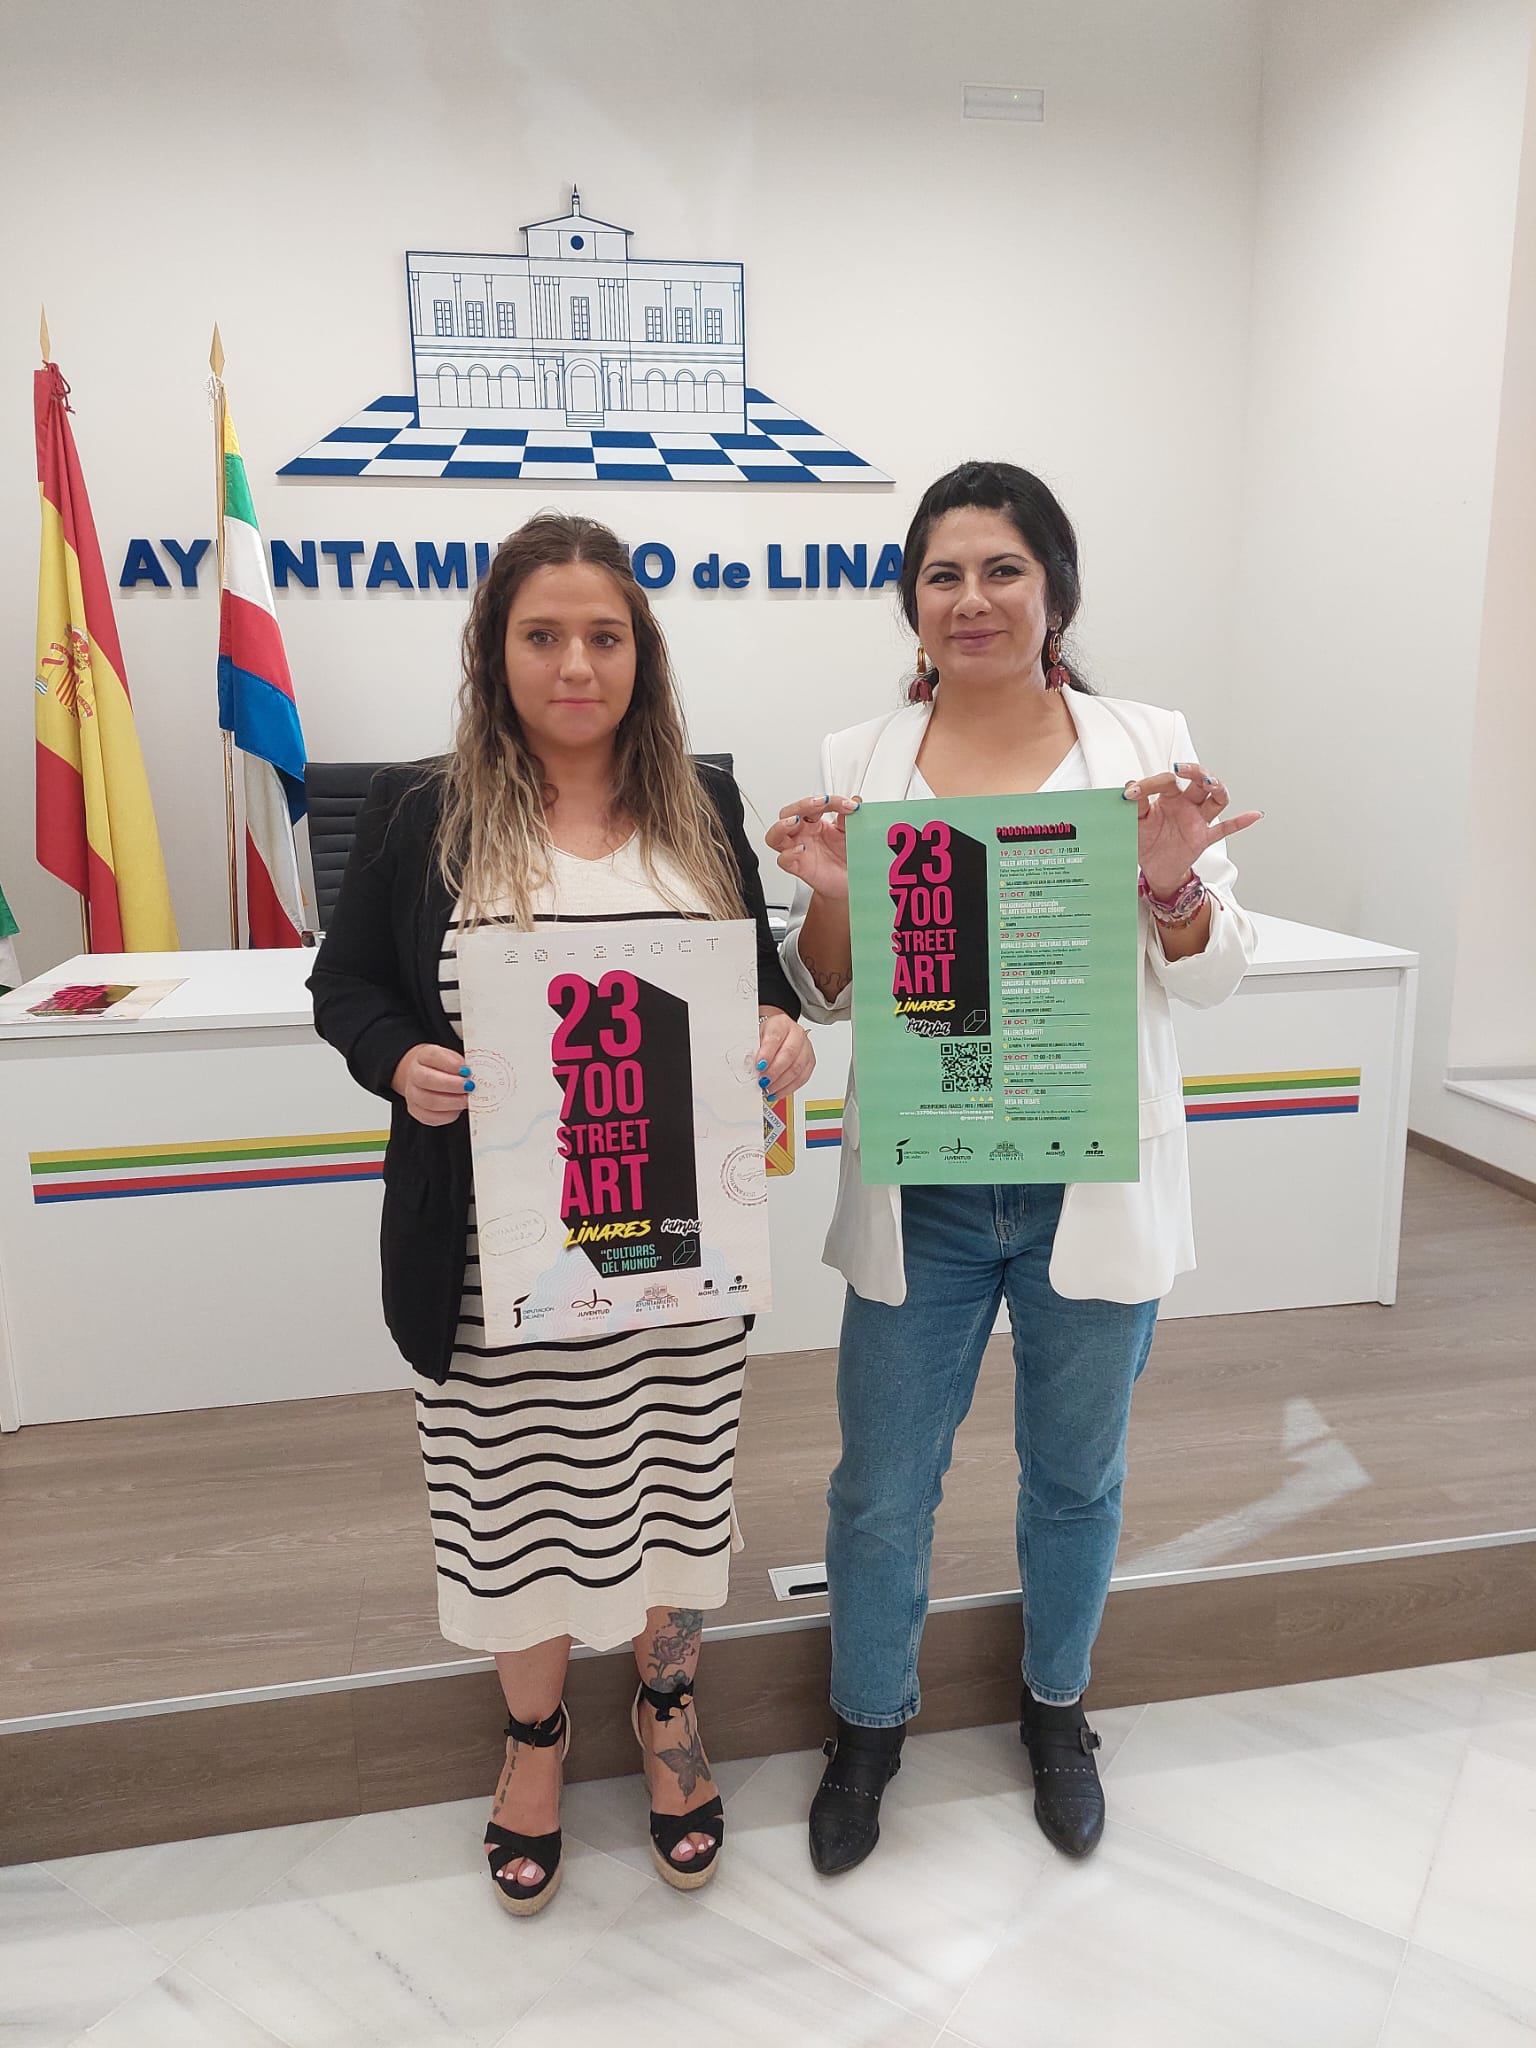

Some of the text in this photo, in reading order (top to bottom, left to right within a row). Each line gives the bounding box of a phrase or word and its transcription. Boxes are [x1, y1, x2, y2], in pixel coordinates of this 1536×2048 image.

[119, 538, 904, 589] AYNTAMIO de LINA
[887, 821, 953, 885] 23
[889, 885, 953, 927] 700
[891, 929, 957, 952] STREET
[893, 954, 956, 995] ART
[547, 969, 642, 1062] 23
[552, 1059, 645, 1120] 700
[556, 1119, 650, 1158] STREET
[560, 1154, 649, 1219] ART
[601, 1261, 620, 1274] DEL
[728, 1284, 748, 1292] mtn
[577, 1308, 610, 1317] JUVENTUD
